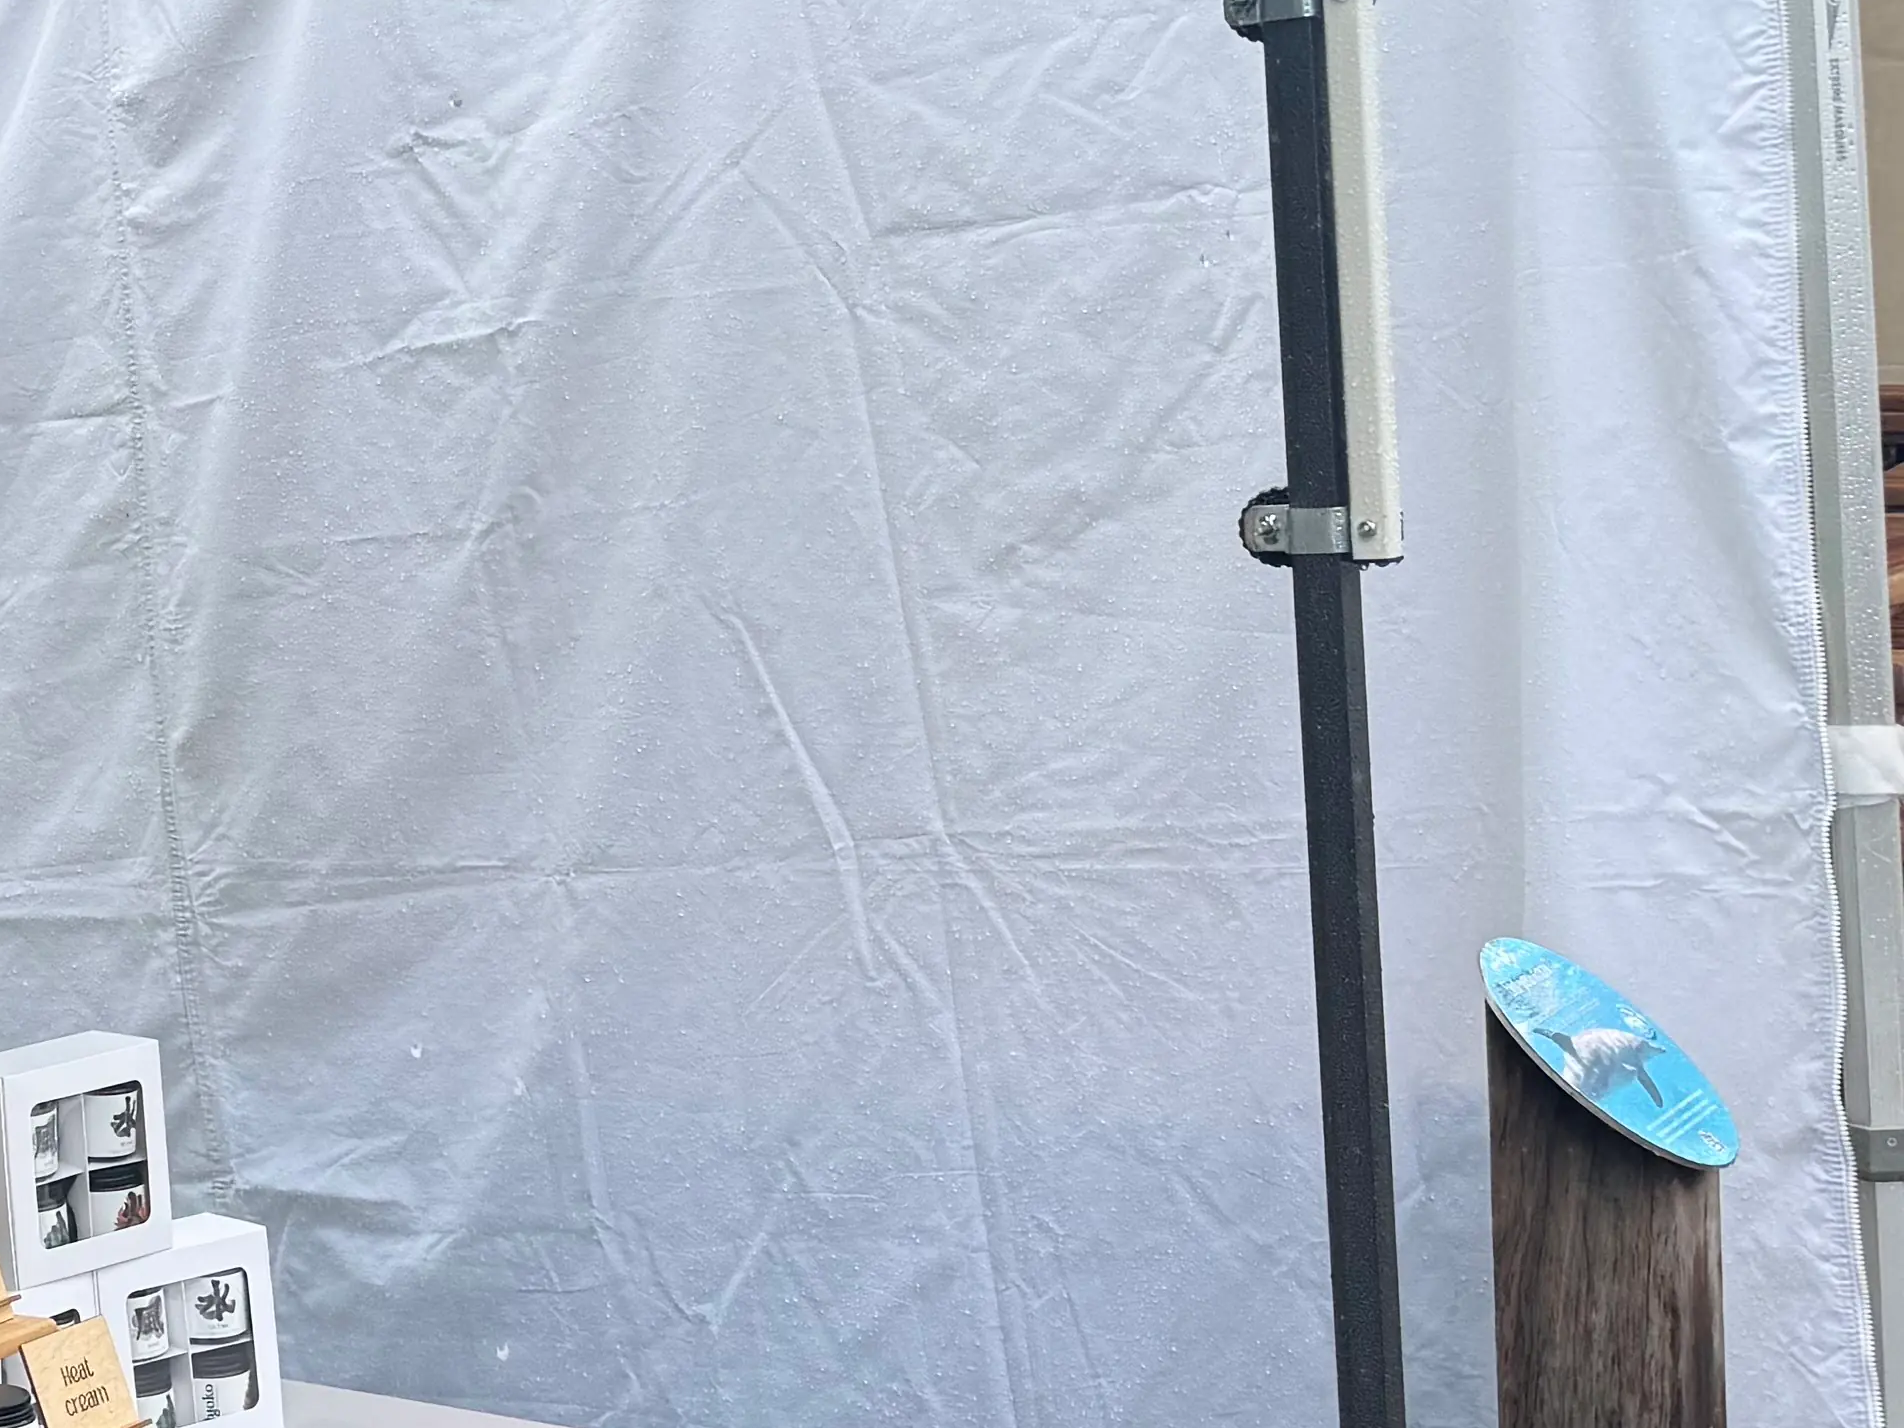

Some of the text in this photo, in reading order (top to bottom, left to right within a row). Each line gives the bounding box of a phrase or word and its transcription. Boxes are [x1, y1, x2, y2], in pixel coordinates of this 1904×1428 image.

[60, 1357, 95, 1386] Heat
[65, 1384, 109, 1417] cream
[201, 1384, 221, 1420] yoko
